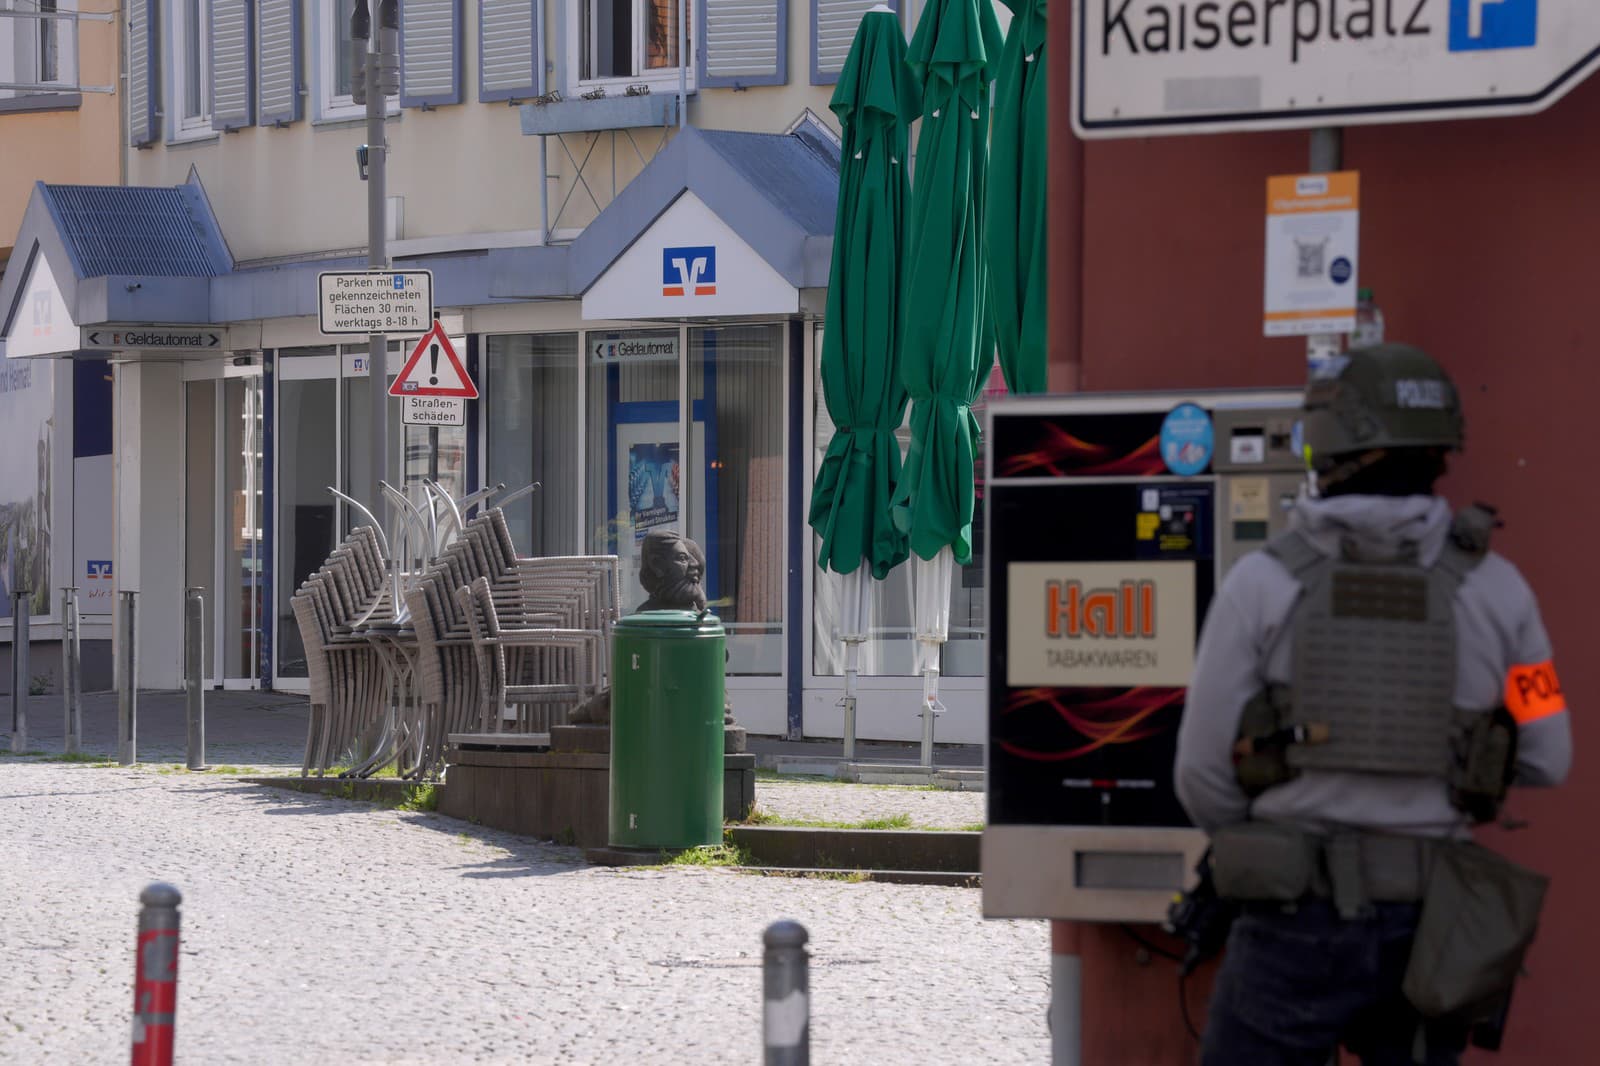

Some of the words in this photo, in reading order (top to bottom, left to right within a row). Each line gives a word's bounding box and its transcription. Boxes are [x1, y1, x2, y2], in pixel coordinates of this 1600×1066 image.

[1102, 0, 1431, 63] Kaiserplatz
[336, 277, 373, 288] Parken
[376, 277, 393, 287] mit
[404, 277, 414, 287] in
[329, 290, 421, 303] gekennzeichneten
[334, 304, 375, 314] Flächen
[378, 303, 391, 313] 30
[395, 303, 417, 313] min.
[334, 317, 382, 329] werktags
[385, 316, 408, 326] 8-18
[411, 316, 418, 326] h
[125, 331, 203, 346] Geldautomat
[618, 340, 674, 356] Geldautomat
[411, 398, 458, 408] Straßen-
[412, 411, 456, 421] schäden
[1046, 579, 1155, 639] Hall
[1046, 648, 1159, 669] TABAKWAREN
